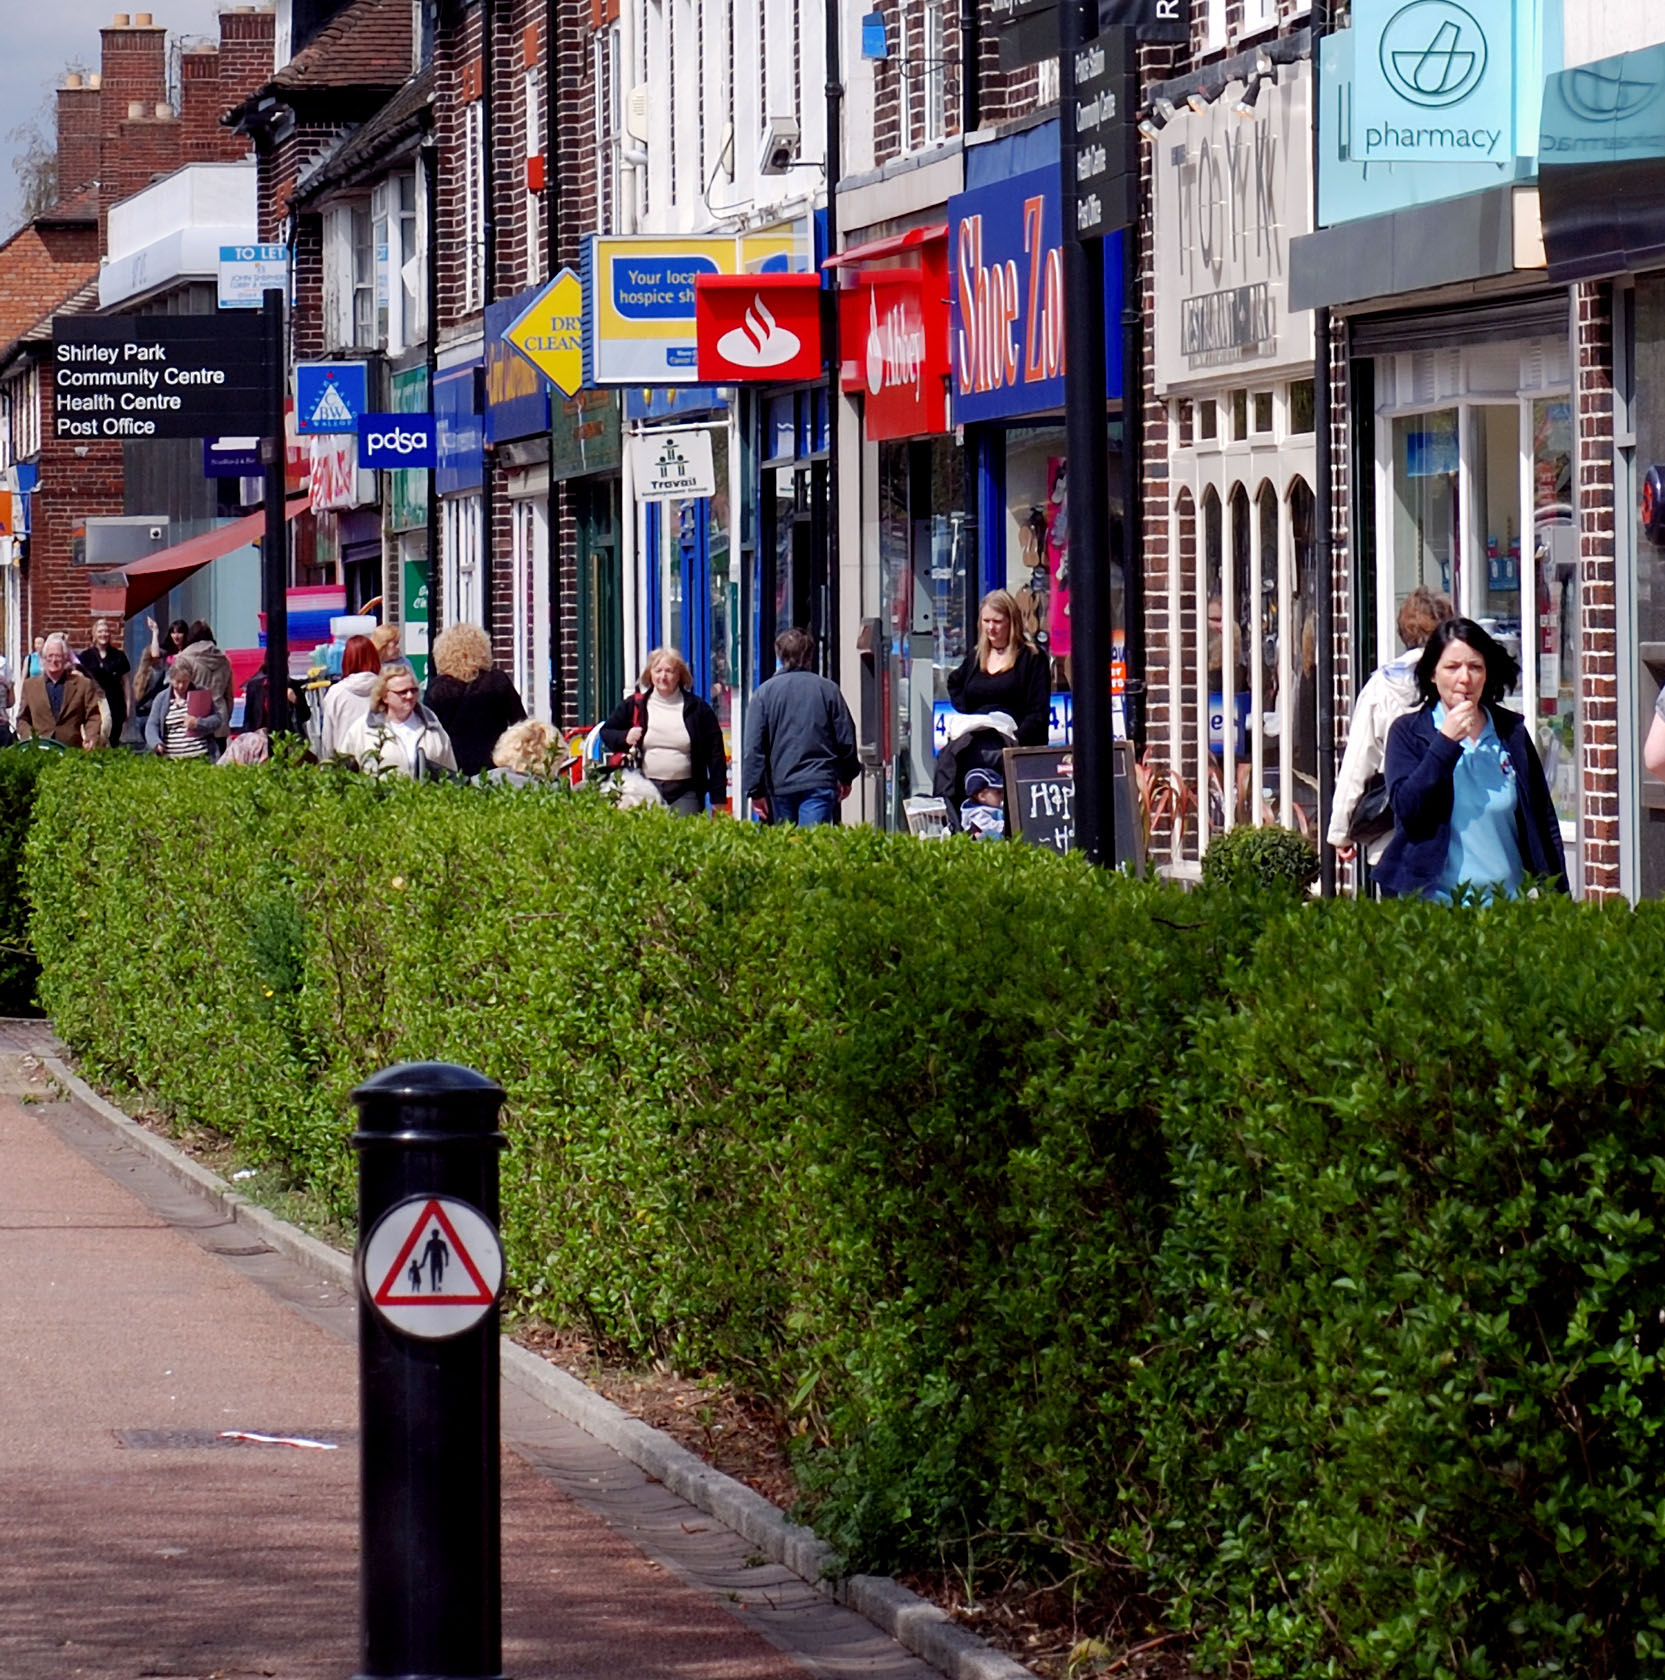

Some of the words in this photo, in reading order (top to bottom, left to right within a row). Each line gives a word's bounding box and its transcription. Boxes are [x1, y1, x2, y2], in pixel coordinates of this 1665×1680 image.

[1366, 121, 1502, 155] pharmacy
[1171, 118, 1271, 276] TOYK
[234, 247, 255, 260] TO
[261, 247, 284, 260] LET
[628, 271, 660, 286] Your
[619, 291, 674, 307] hospice
[957, 214, 1020, 396] Shoe
[1023, 194, 1067, 384] Zo
[552, 316, 582, 331] DRY
[57, 344, 119, 365] Shirley
[124, 343, 166, 361] Park
[57, 368, 159, 388] Community
[164, 368, 225, 384] Centre
[57, 394, 115, 411] Health
[120, 393, 182, 410] Centre
[57, 418, 98, 435] Post
[103, 418, 156, 435] Office
[368, 426, 428, 456] pdsa
[651, 477, 697, 490] Travail
